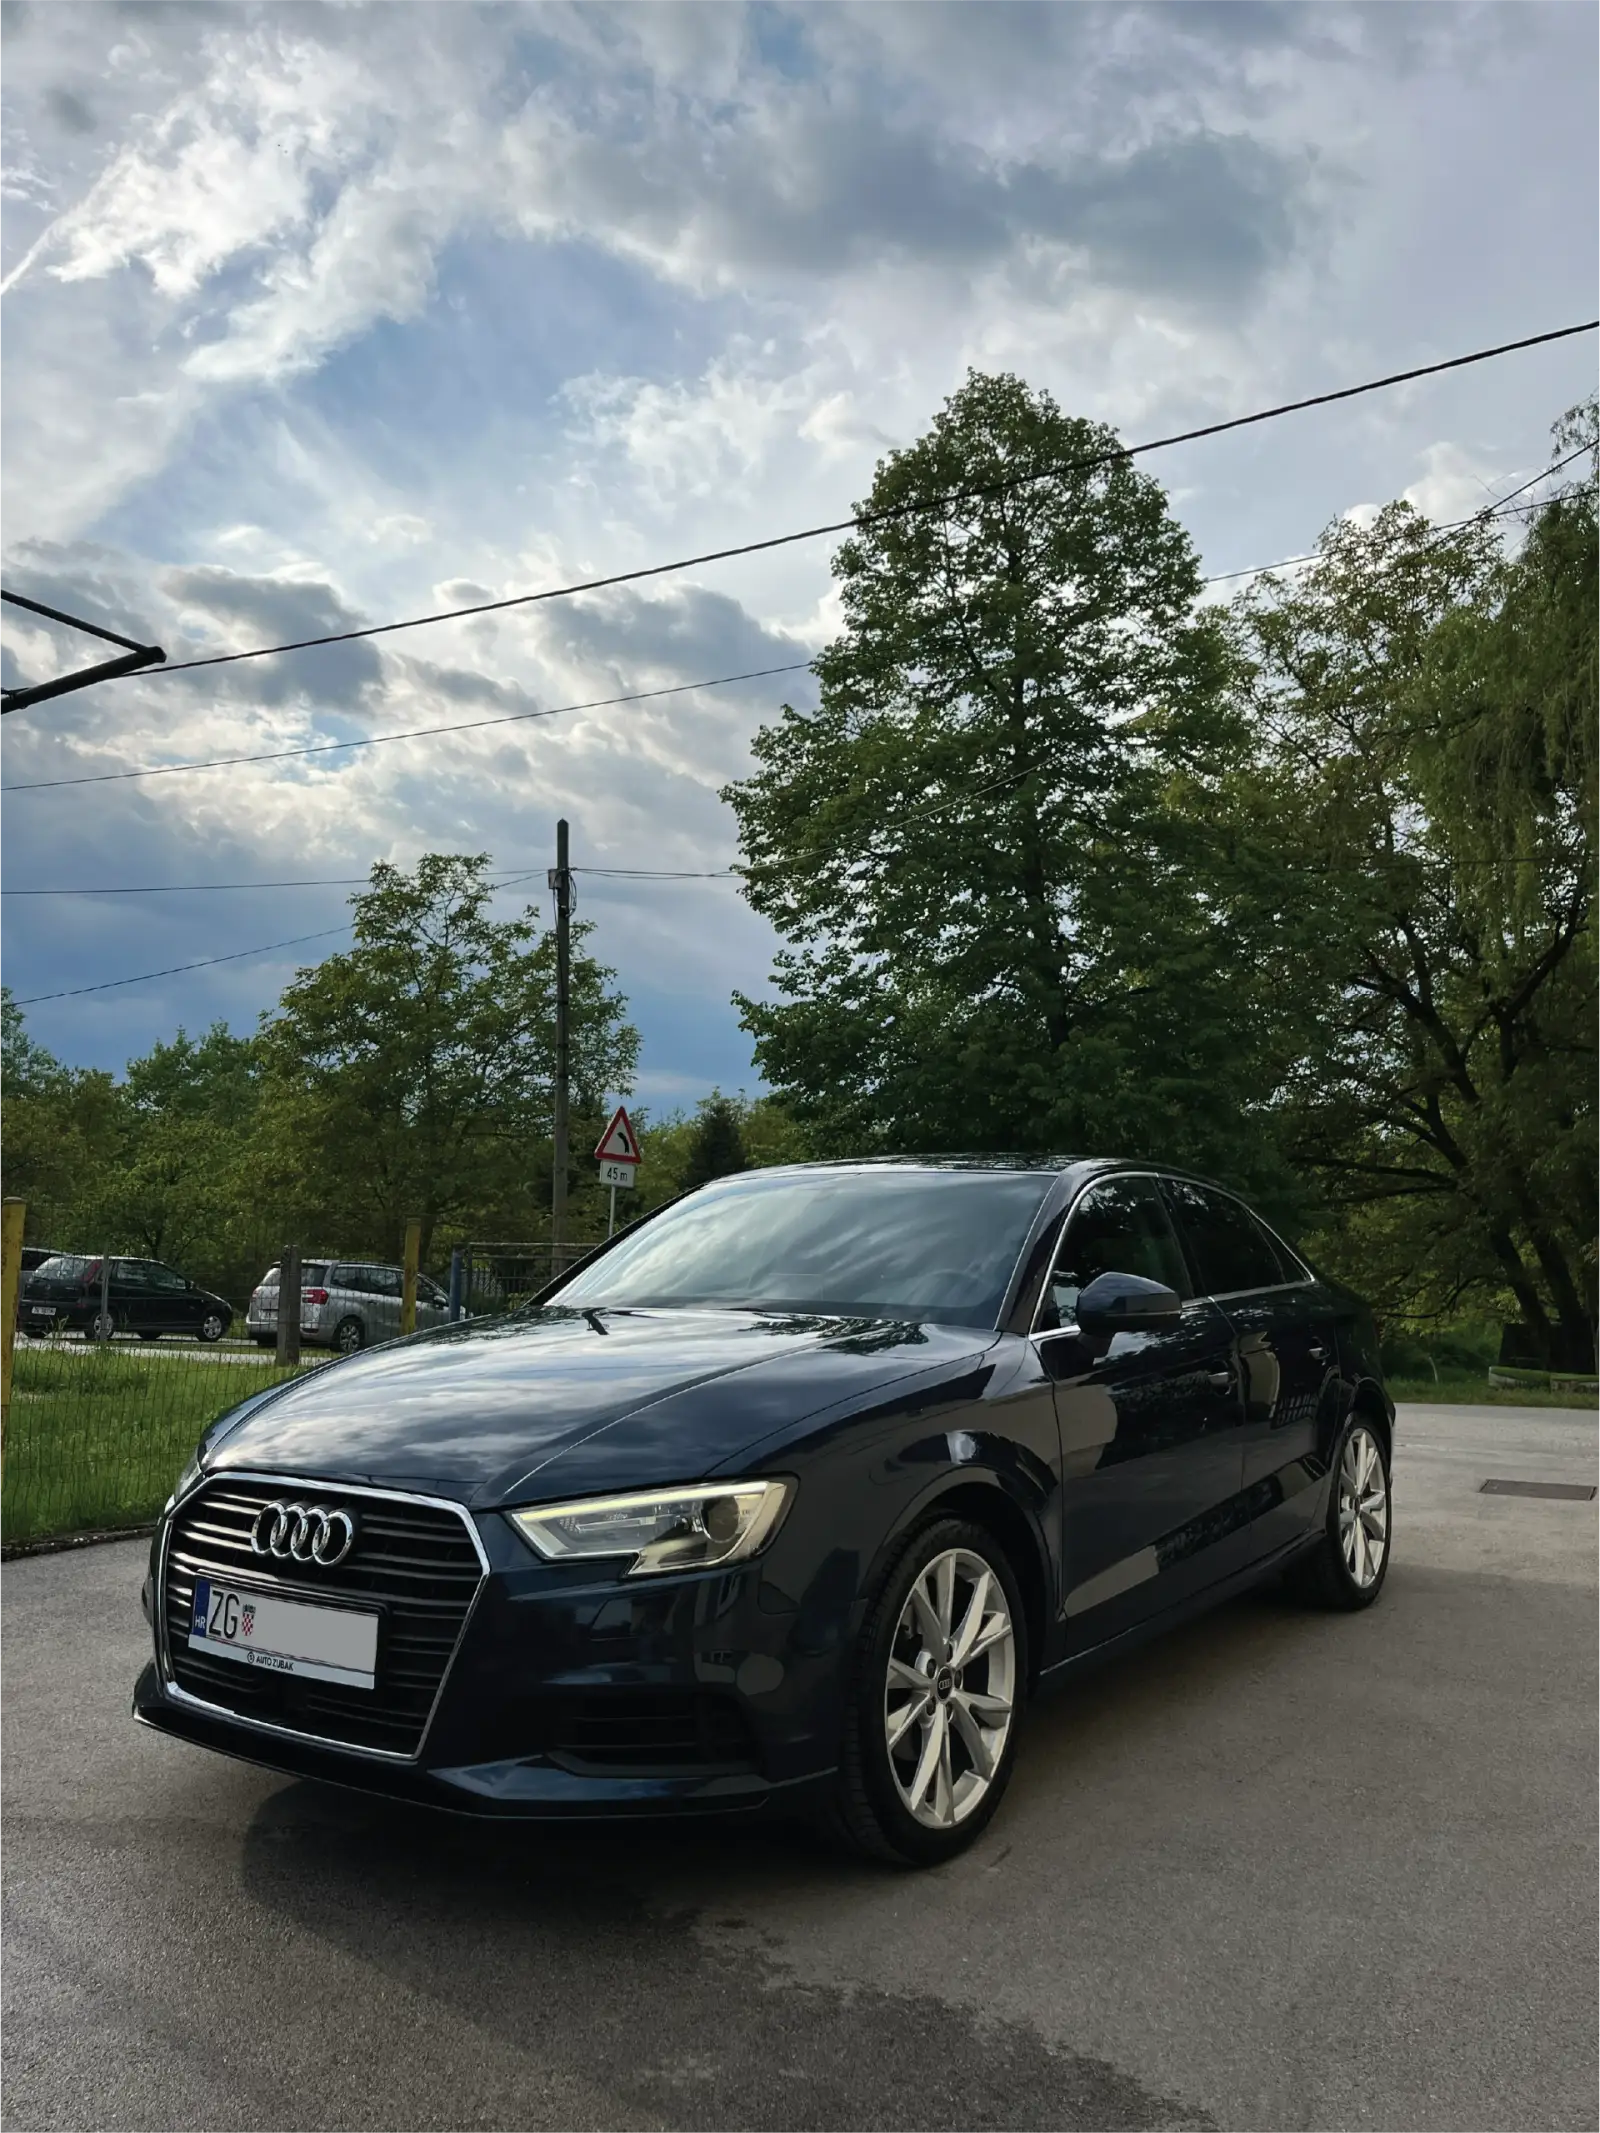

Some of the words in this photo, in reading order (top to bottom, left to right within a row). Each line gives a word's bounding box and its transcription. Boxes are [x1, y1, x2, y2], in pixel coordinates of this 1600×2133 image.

[607, 1167, 619, 1180] 45
[620, 1171, 628, 1182] m
[195, 1615, 206, 1629] HR
[208, 1590, 240, 1639] ZG
[256, 1655, 272, 1666] AUTO
[272, 1658, 294, 1671] ZUBAK
